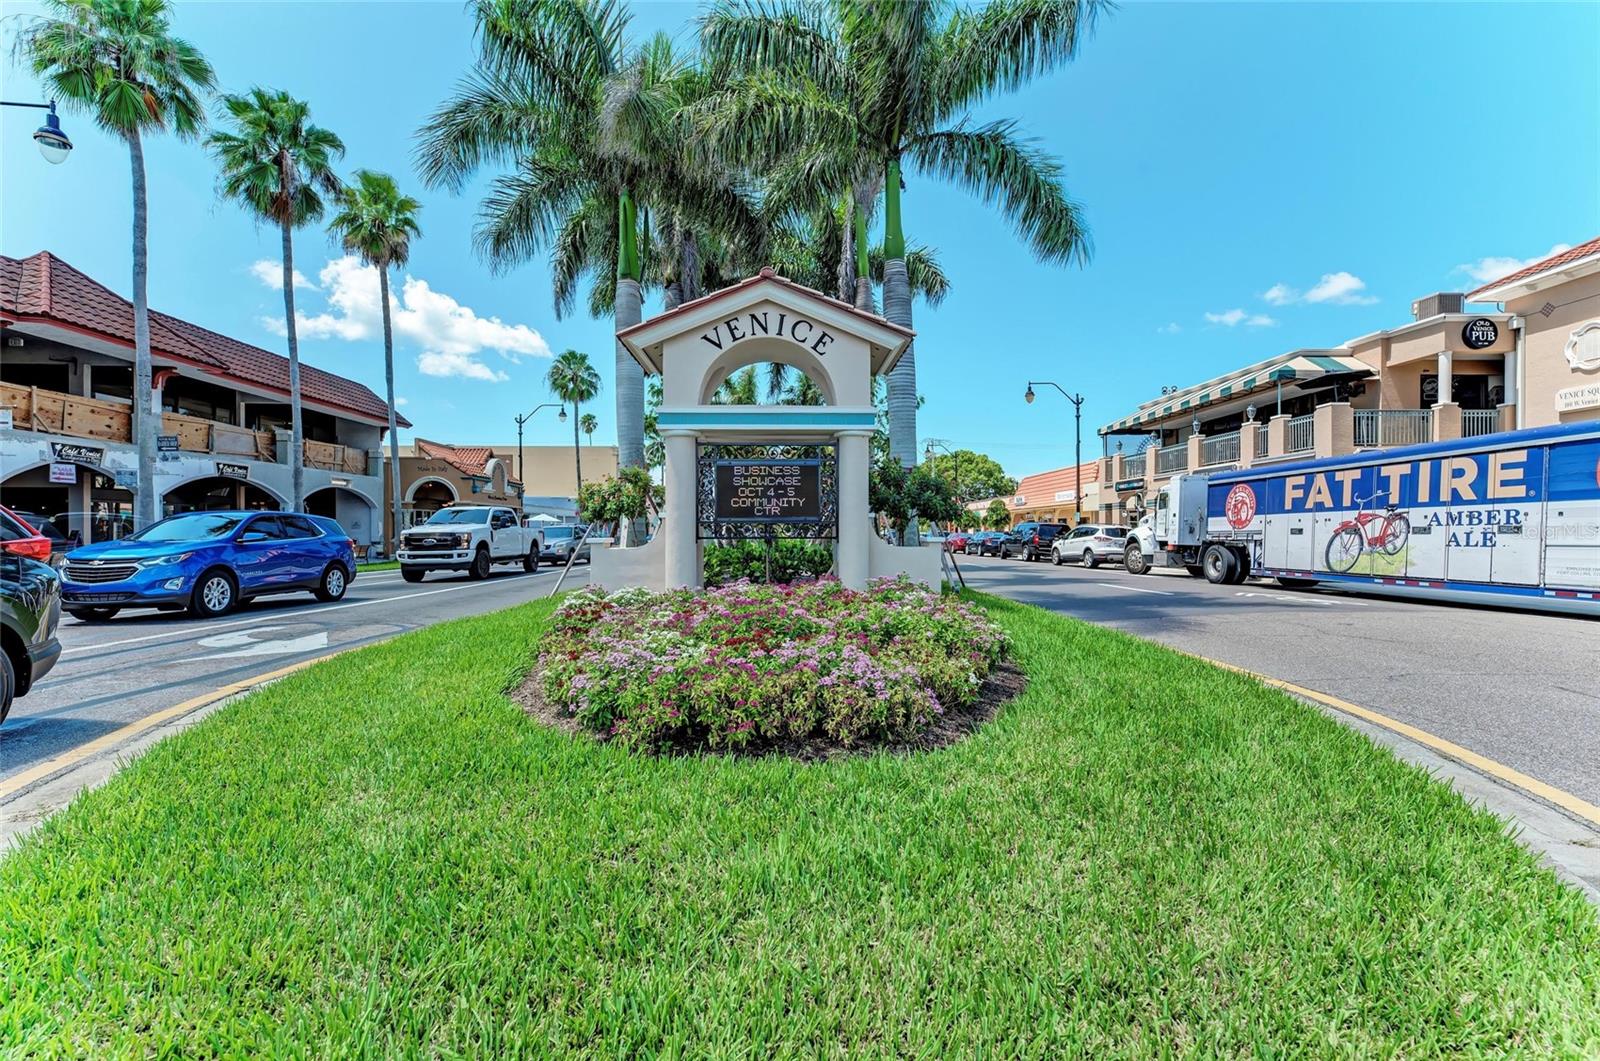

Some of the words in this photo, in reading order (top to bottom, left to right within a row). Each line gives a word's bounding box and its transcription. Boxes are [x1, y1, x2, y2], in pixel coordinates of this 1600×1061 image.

[701, 312, 835, 356] VENICE
[1472, 331, 1496, 341] PUB
[1559, 389, 1585, 400] VENICE
[80, 447, 101, 458] Venice
[733, 466, 801, 475] BUSINESS
[733, 477, 801, 486] SHOWCASE
[1284, 471, 1361, 511] FAT
[1380, 450, 1528, 506] TIRE
[738, 487, 764, 496] OCT
[767, 488, 775, 496] 4
[730, 498, 806, 507] COMMUNITY
[754, 507, 780, 515] CTR
[1427, 508, 1522, 527] AMBER
[1446, 531, 1497, 549] ALE
